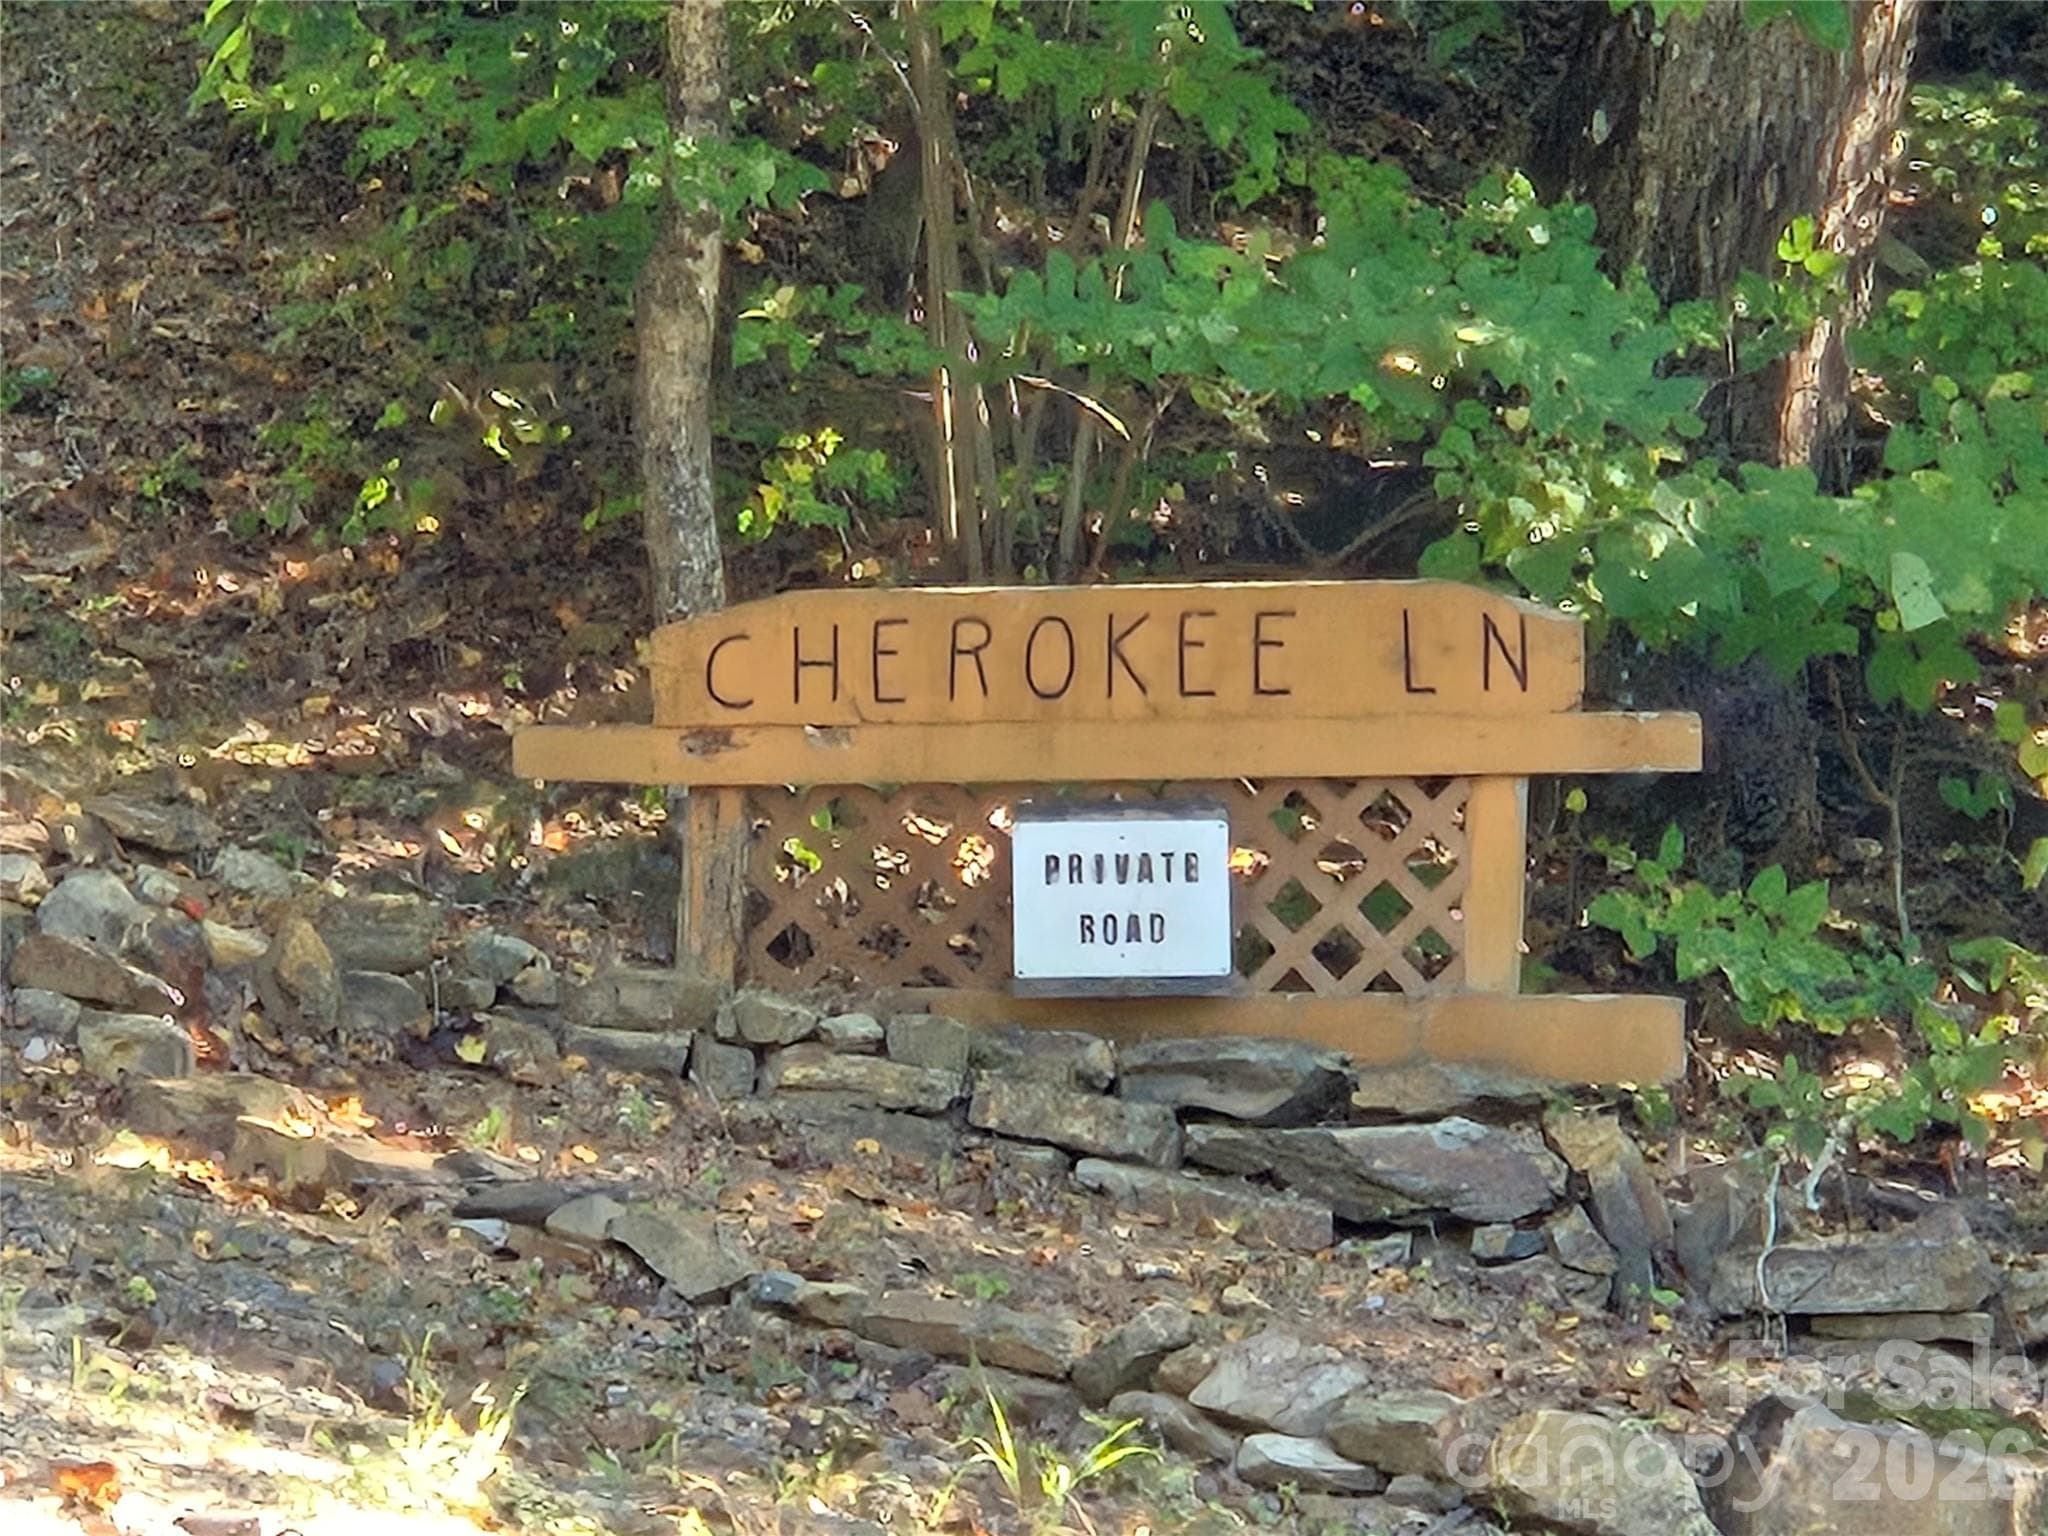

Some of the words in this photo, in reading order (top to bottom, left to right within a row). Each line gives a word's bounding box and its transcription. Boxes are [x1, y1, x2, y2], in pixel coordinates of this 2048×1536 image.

[705, 608, 1297, 709] CHEROKEE
[1403, 607, 1529, 695] LN
[1044, 852, 1200, 885] PRIVATE
[1079, 912, 1166, 946] ROAD
